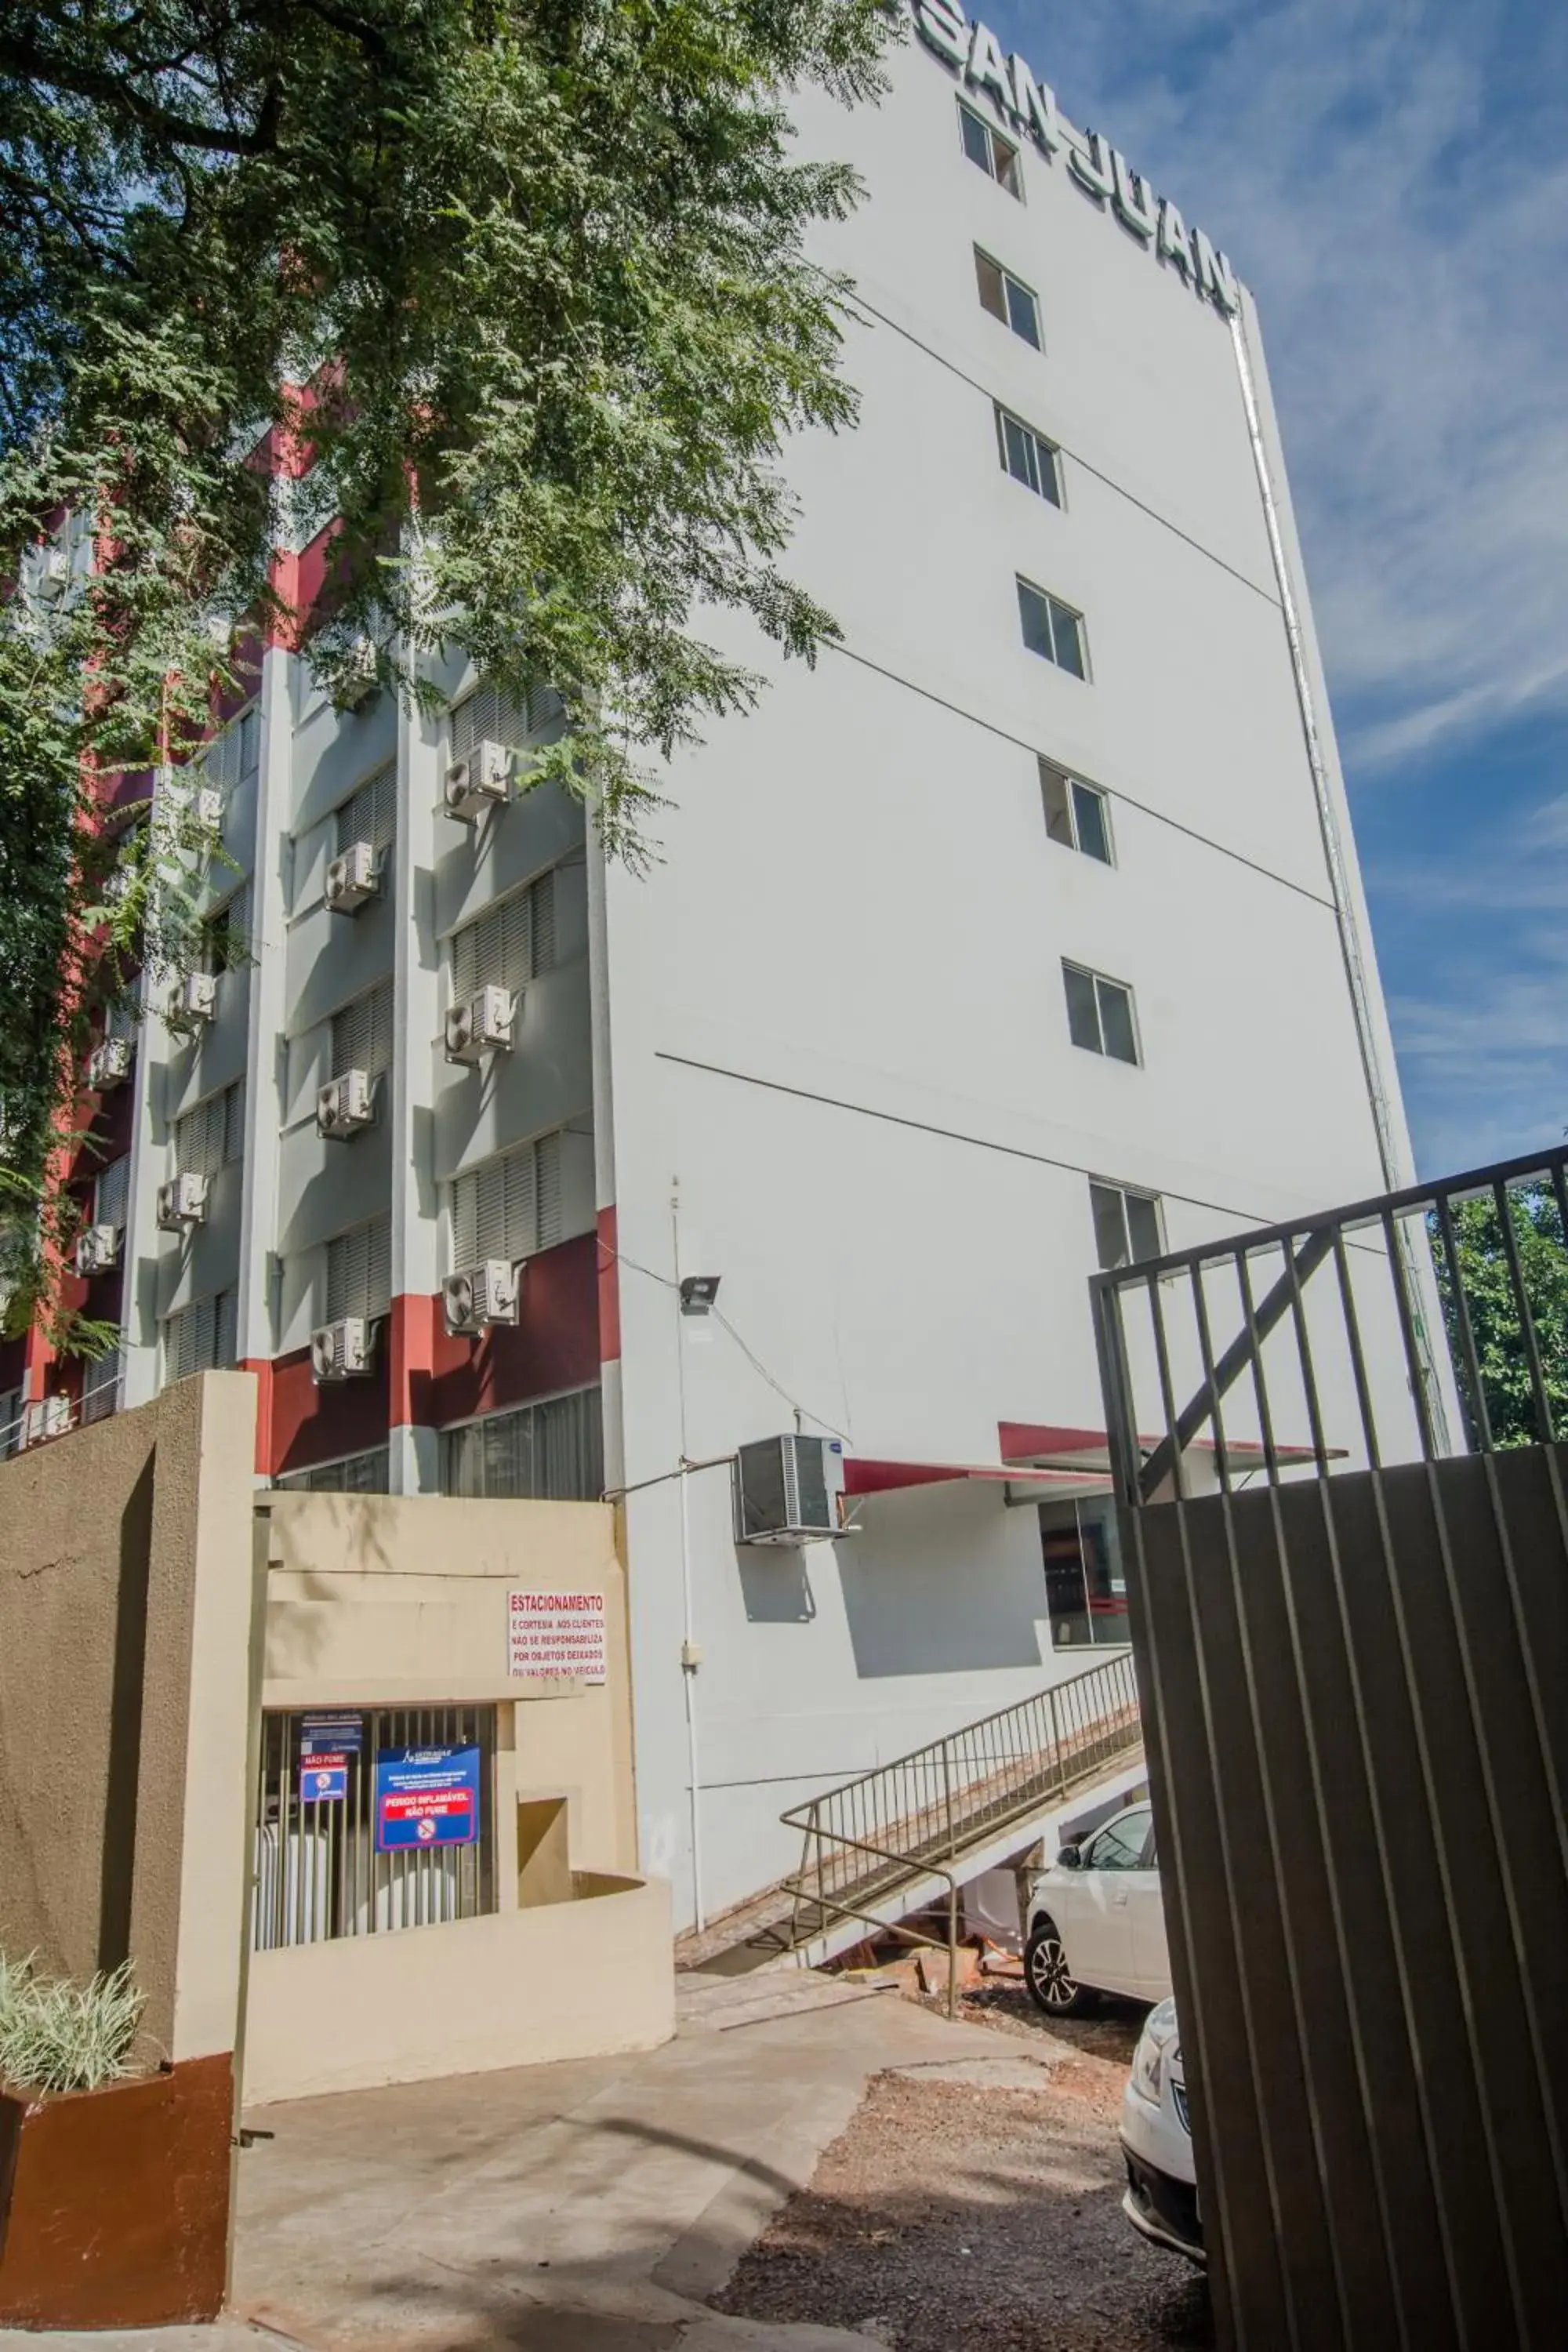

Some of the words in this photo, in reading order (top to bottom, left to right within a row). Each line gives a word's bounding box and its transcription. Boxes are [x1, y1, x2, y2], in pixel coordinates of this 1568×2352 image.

[912, 0, 1059, 153] SAN
[1069, 132, 1239, 315] JUAN
[511, 1595, 603, 1611] ESTACIONAMENTO
[518, 1619, 554, 1630] CORTESIA
[557, 1619, 572, 1629] AOS
[572, 1618, 604, 1628] CLIENTES
[529, 1635, 539, 1646] SE
[540, 1634, 603, 1646] RESPONSABILIZA
[514, 1651, 529, 1661] POR
[531, 1650, 565, 1661] OBJETOS
[566, 1649, 603, 1660] DEIXADOS
